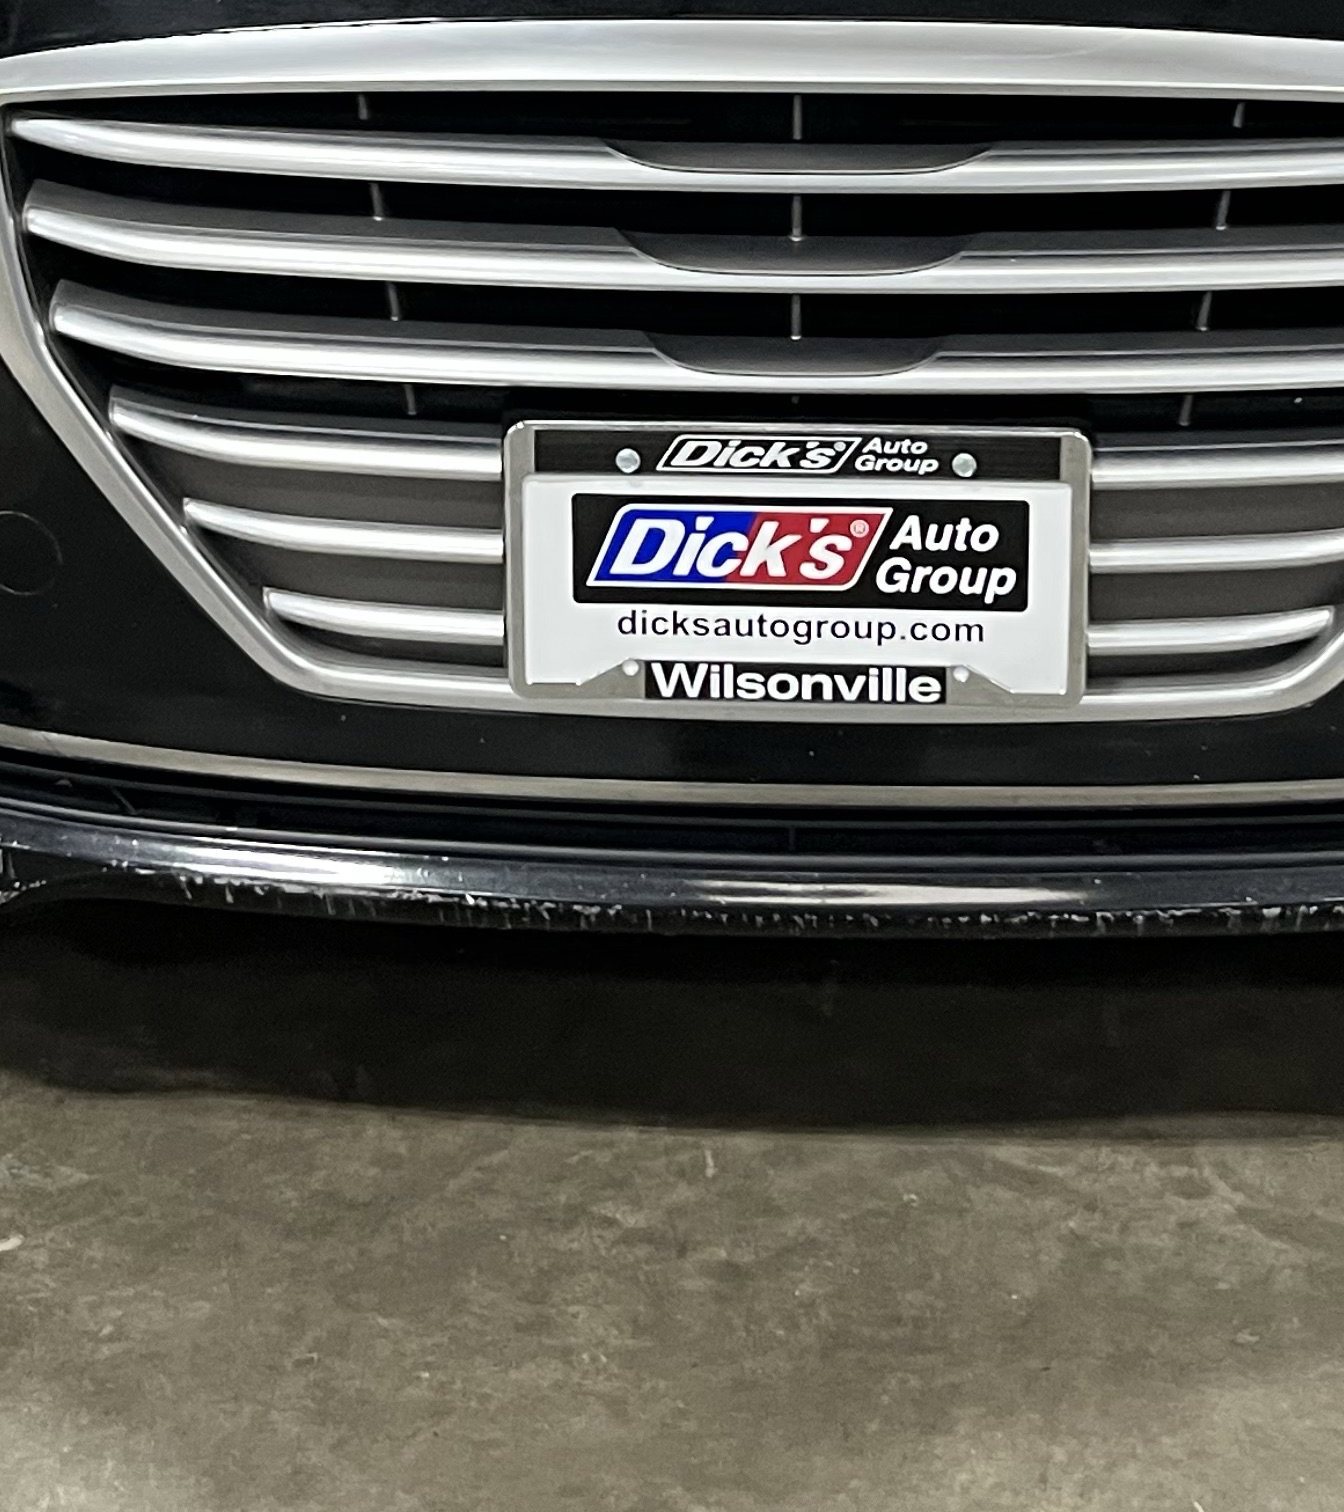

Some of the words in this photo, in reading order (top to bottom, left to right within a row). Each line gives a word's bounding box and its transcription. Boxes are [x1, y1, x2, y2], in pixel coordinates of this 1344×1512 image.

[670, 440, 836, 470] Dick's
[862, 437, 929, 455] Auto
[854, 454, 940, 475] Group
[610, 515, 855, 581] Dick's
[889, 515, 999, 553] Auto
[875, 558, 1018, 604] Group
[617, 610, 986, 645] dicksautogroup.com
[652, 662, 943, 703] Wilsonville
